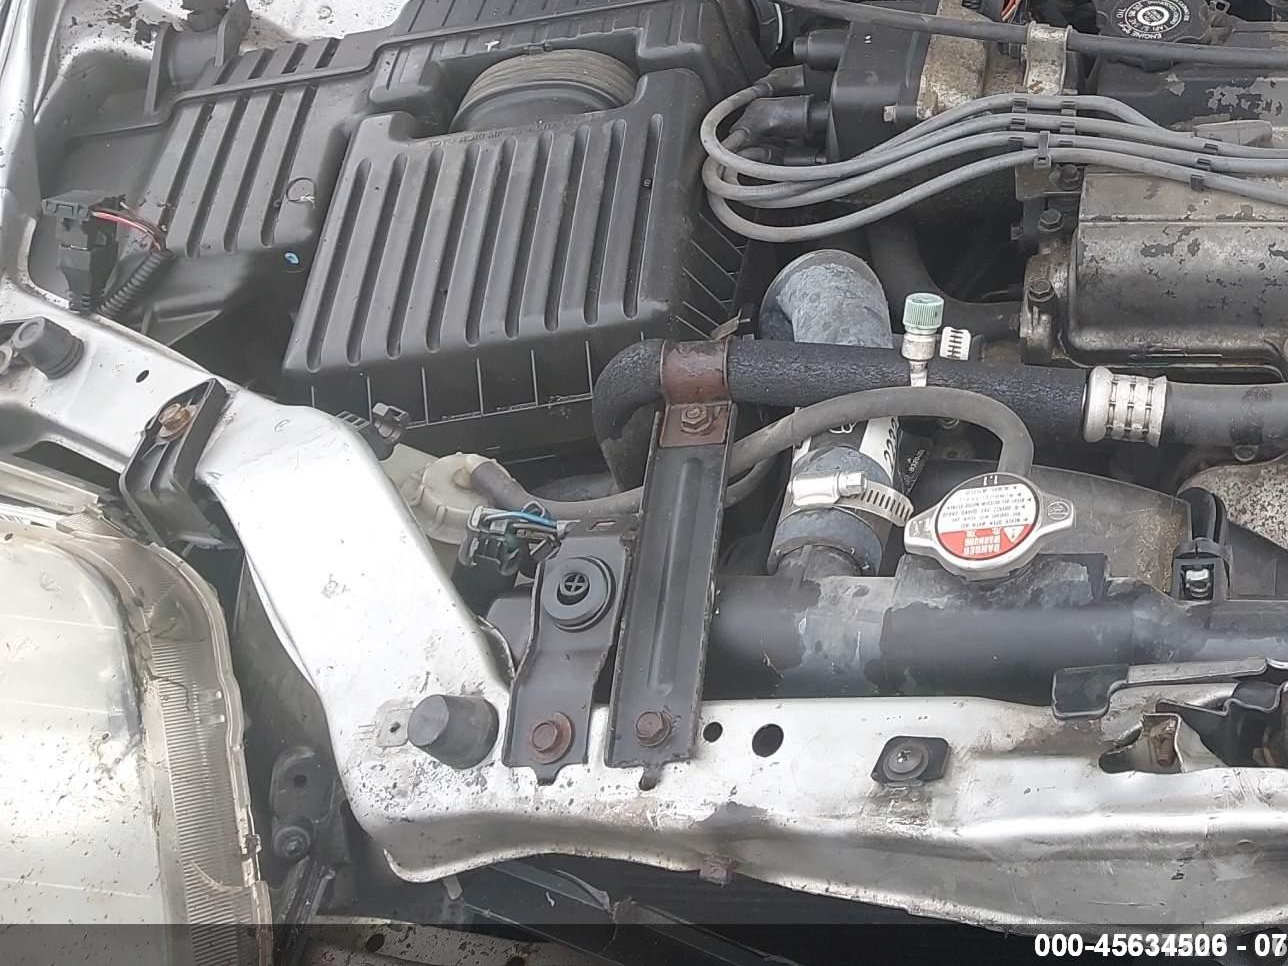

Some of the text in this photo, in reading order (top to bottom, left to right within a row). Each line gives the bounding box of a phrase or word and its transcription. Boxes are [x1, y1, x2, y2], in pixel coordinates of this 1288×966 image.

[1115, 8, 1163, 41] ENGINE OIL
[963, 544, 1000, 555] DANGER
